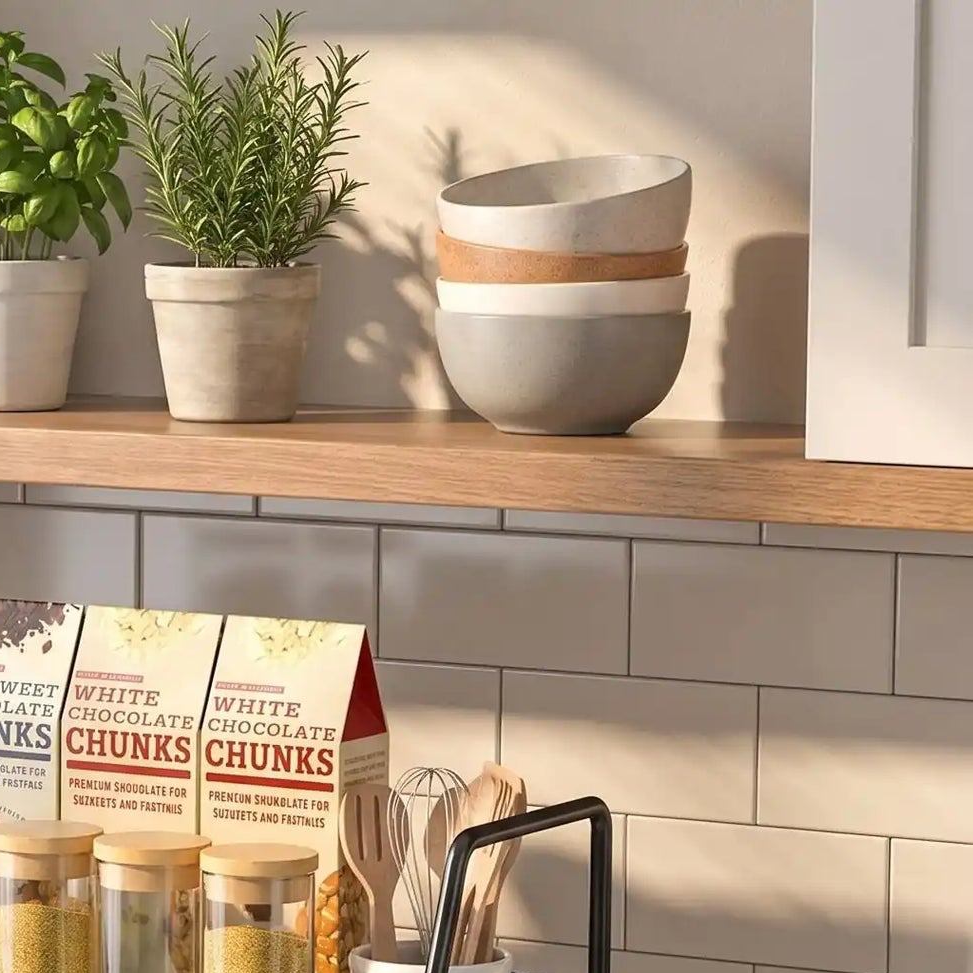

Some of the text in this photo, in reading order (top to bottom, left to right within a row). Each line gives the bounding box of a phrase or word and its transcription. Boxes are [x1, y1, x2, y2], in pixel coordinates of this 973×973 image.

[75, 685, 160, 707] WHITE
[213, 696, 301, 718] WHITE
[68, 706, 194, 730] CHOCOLATE
[207, 718, 336, 742] CHOCOLATE
[66, 727, 191, 764] CHUNKS
[205, 738, 334, 776] CHUNKS
[69, 777, 111, 791] PREMIUM
[169, 787, 187, 798] FOR
[119, 799, 138, 810] AND
[311, 800, 330, 812] FOR
[260, 812, 279, 824] AND
